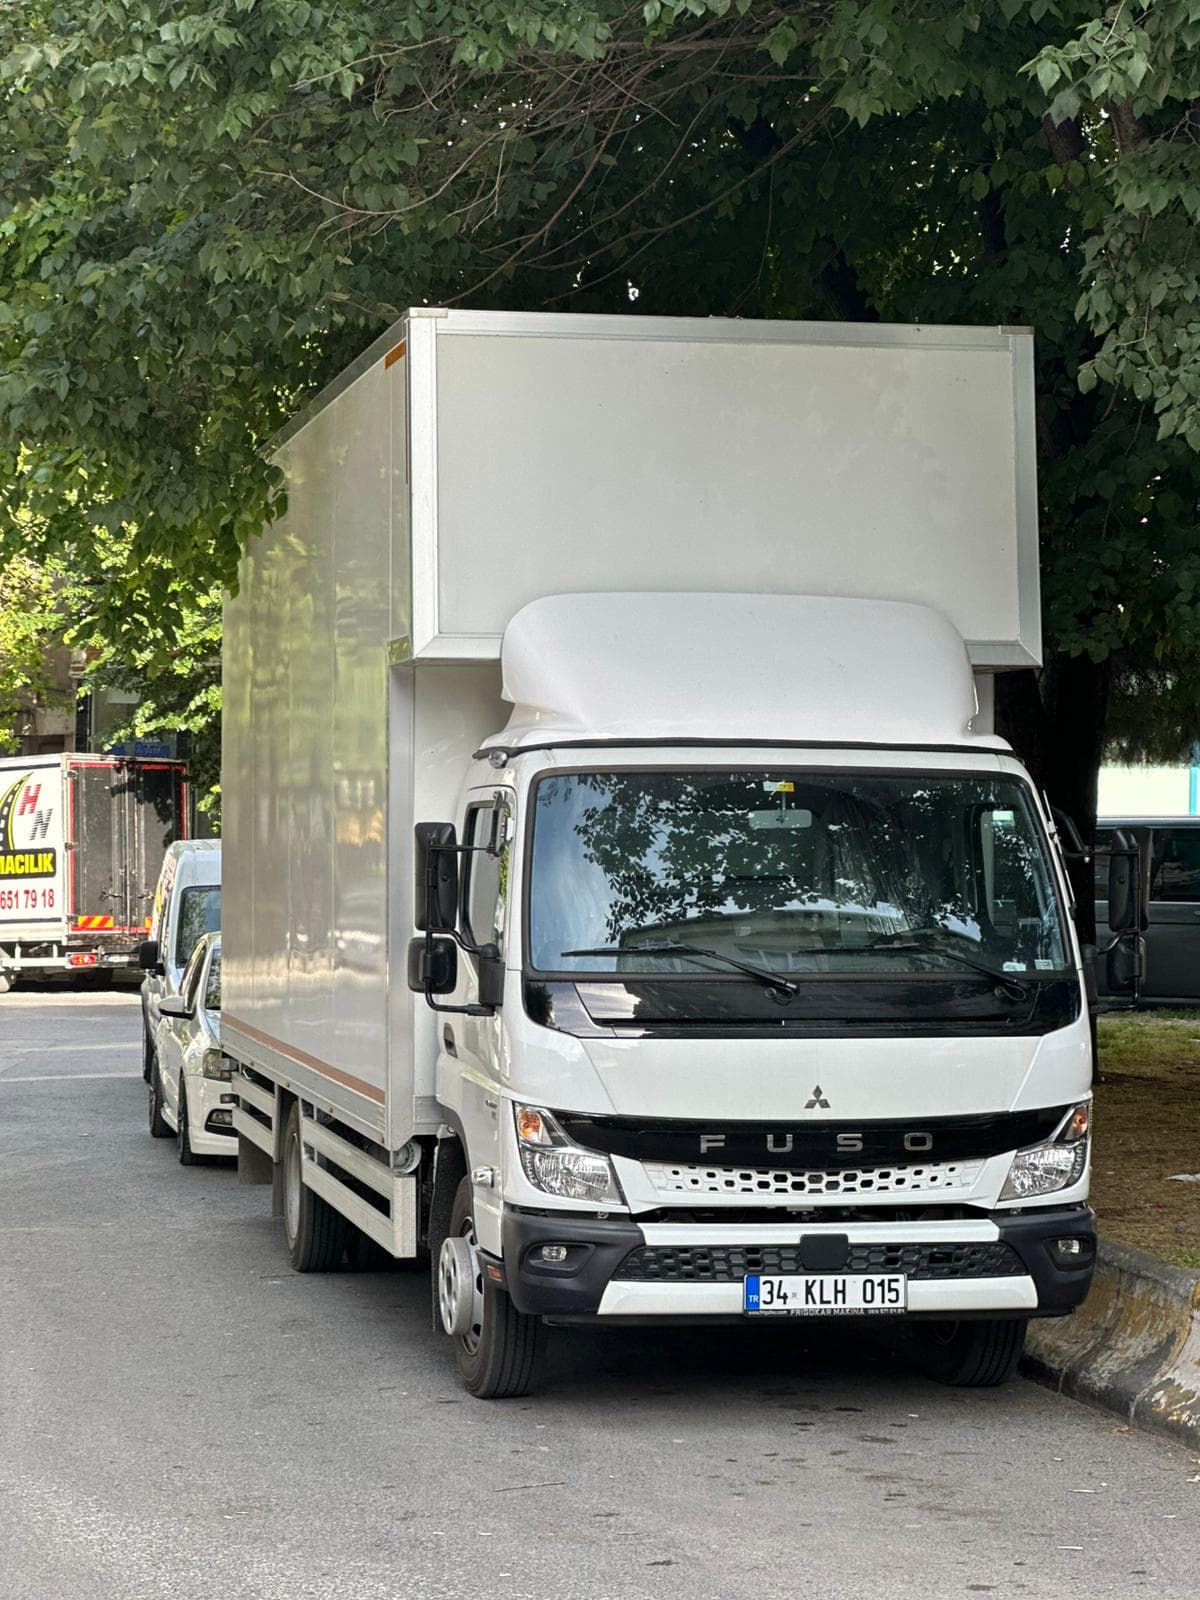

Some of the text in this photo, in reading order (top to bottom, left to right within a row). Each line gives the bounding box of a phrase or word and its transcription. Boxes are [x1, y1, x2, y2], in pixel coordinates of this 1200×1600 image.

[18, 784, 41, 815] H
[29, 808, 53, 840] N
[0, 888, 54, 909] 651 79 18
[699, 1132, 933, 1154] FUSO
[748, 1278, 900, 1305] TR 34 KLH 015
